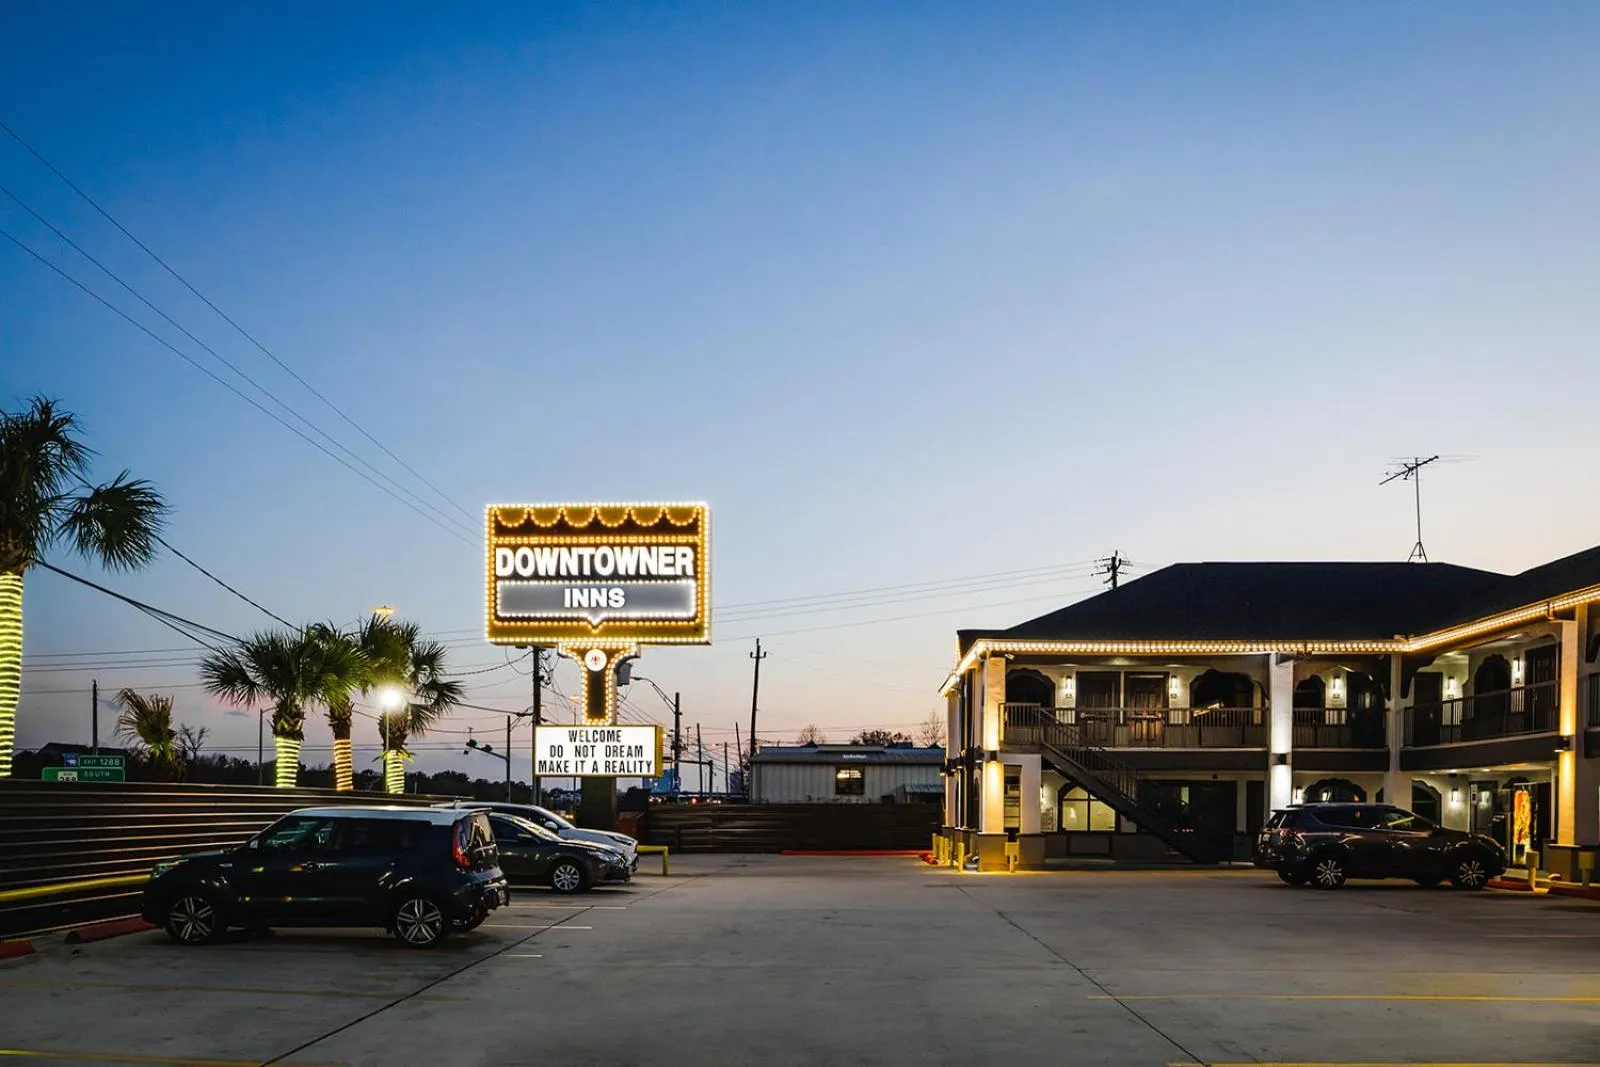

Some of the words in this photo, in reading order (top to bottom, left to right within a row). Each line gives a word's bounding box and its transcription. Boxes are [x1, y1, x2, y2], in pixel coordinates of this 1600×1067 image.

[495, 546, 694, 576] DOWNTOWNER
[564, 588, 625, 608] INNS
[568, 730, 621, 742] WELCOME
[550, 745, 563, 758] DO
[575, 745, 596, 758] NOT
[605, 745, 643, 758] DREAM
[100, 758, 121, 766] 128B
[538, 760, 569, 773] MAKE
[575, 760, 586, 773] IT
[592, 760, 599, 773] A
[605, 760, 652, 773] REALITY
